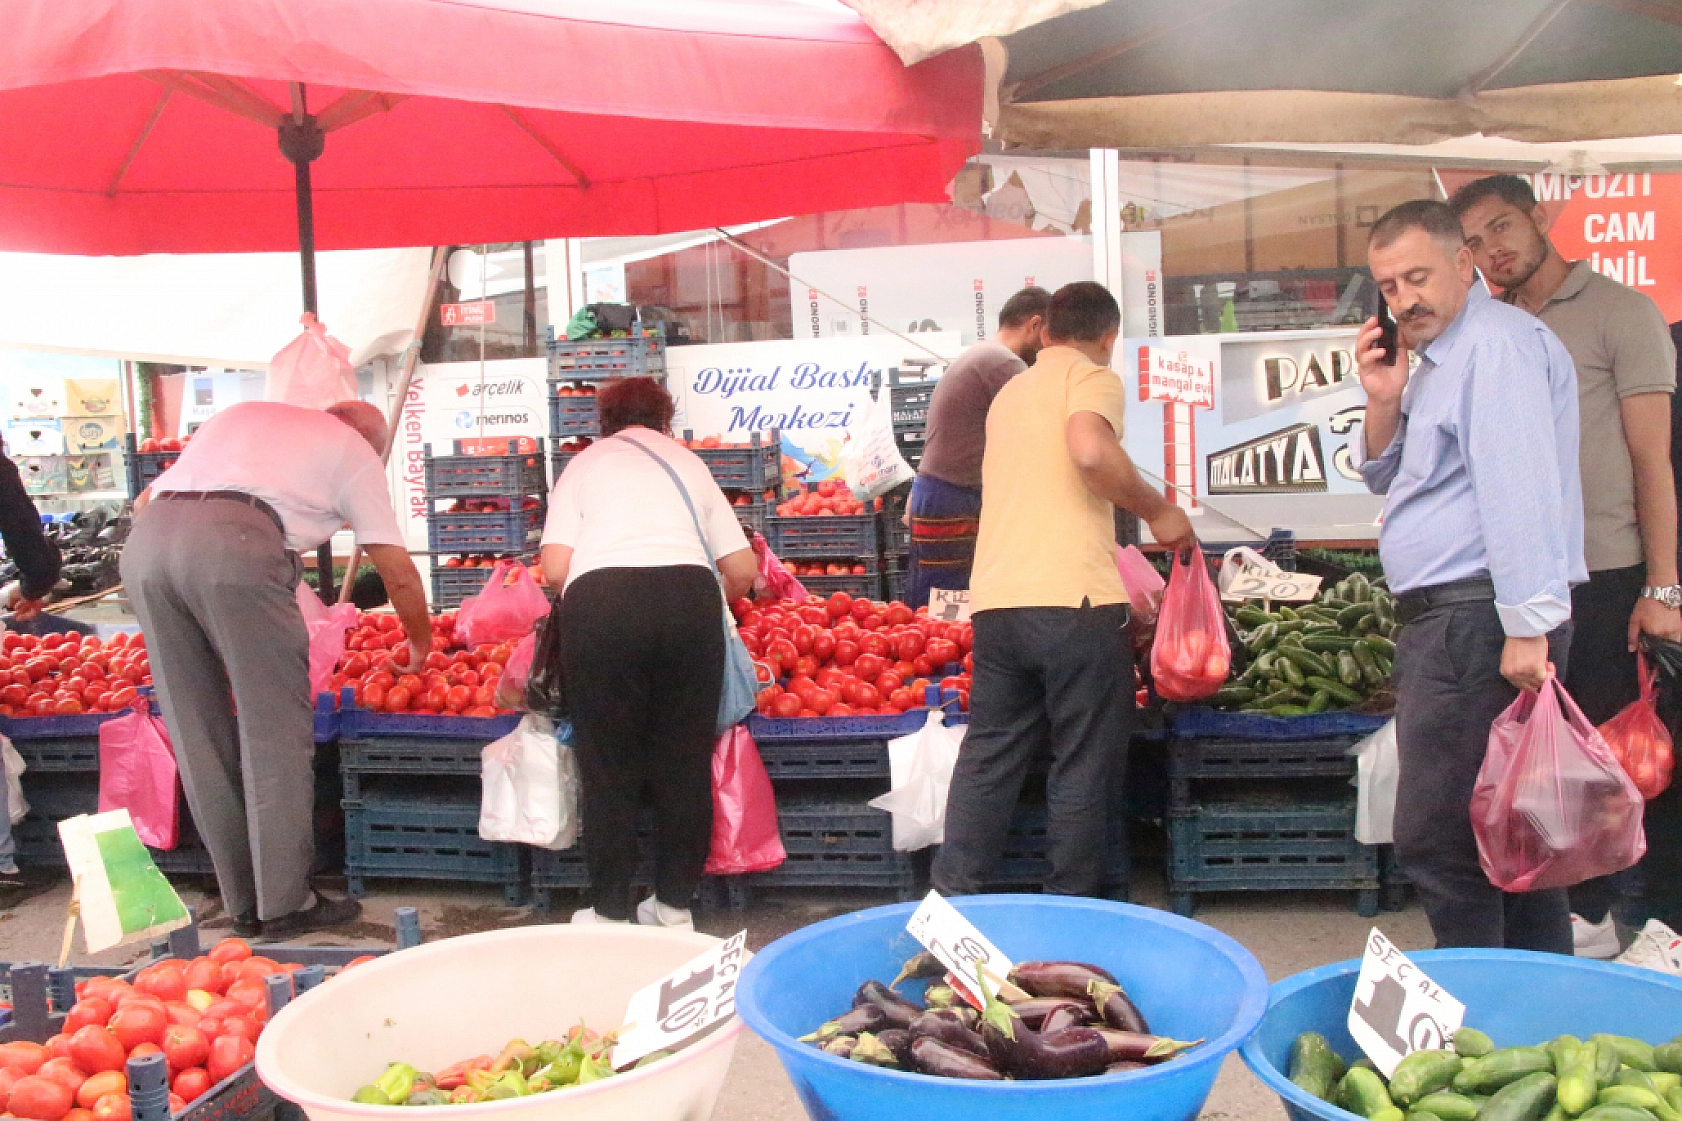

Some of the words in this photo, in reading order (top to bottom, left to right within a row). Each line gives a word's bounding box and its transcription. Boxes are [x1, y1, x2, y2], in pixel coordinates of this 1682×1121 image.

[1584, 211, 1656, 243] CAM
[1569, 250, 1656, 287] İNİL
[1158, 355, 1194, 378] kasap
[1265, 349, 1358, 401] PAP
[472, 379, 526, 400] arçelik
[1152, 375, 1192, 393] mangal
[727, 402, 856, 433] Merkezi
